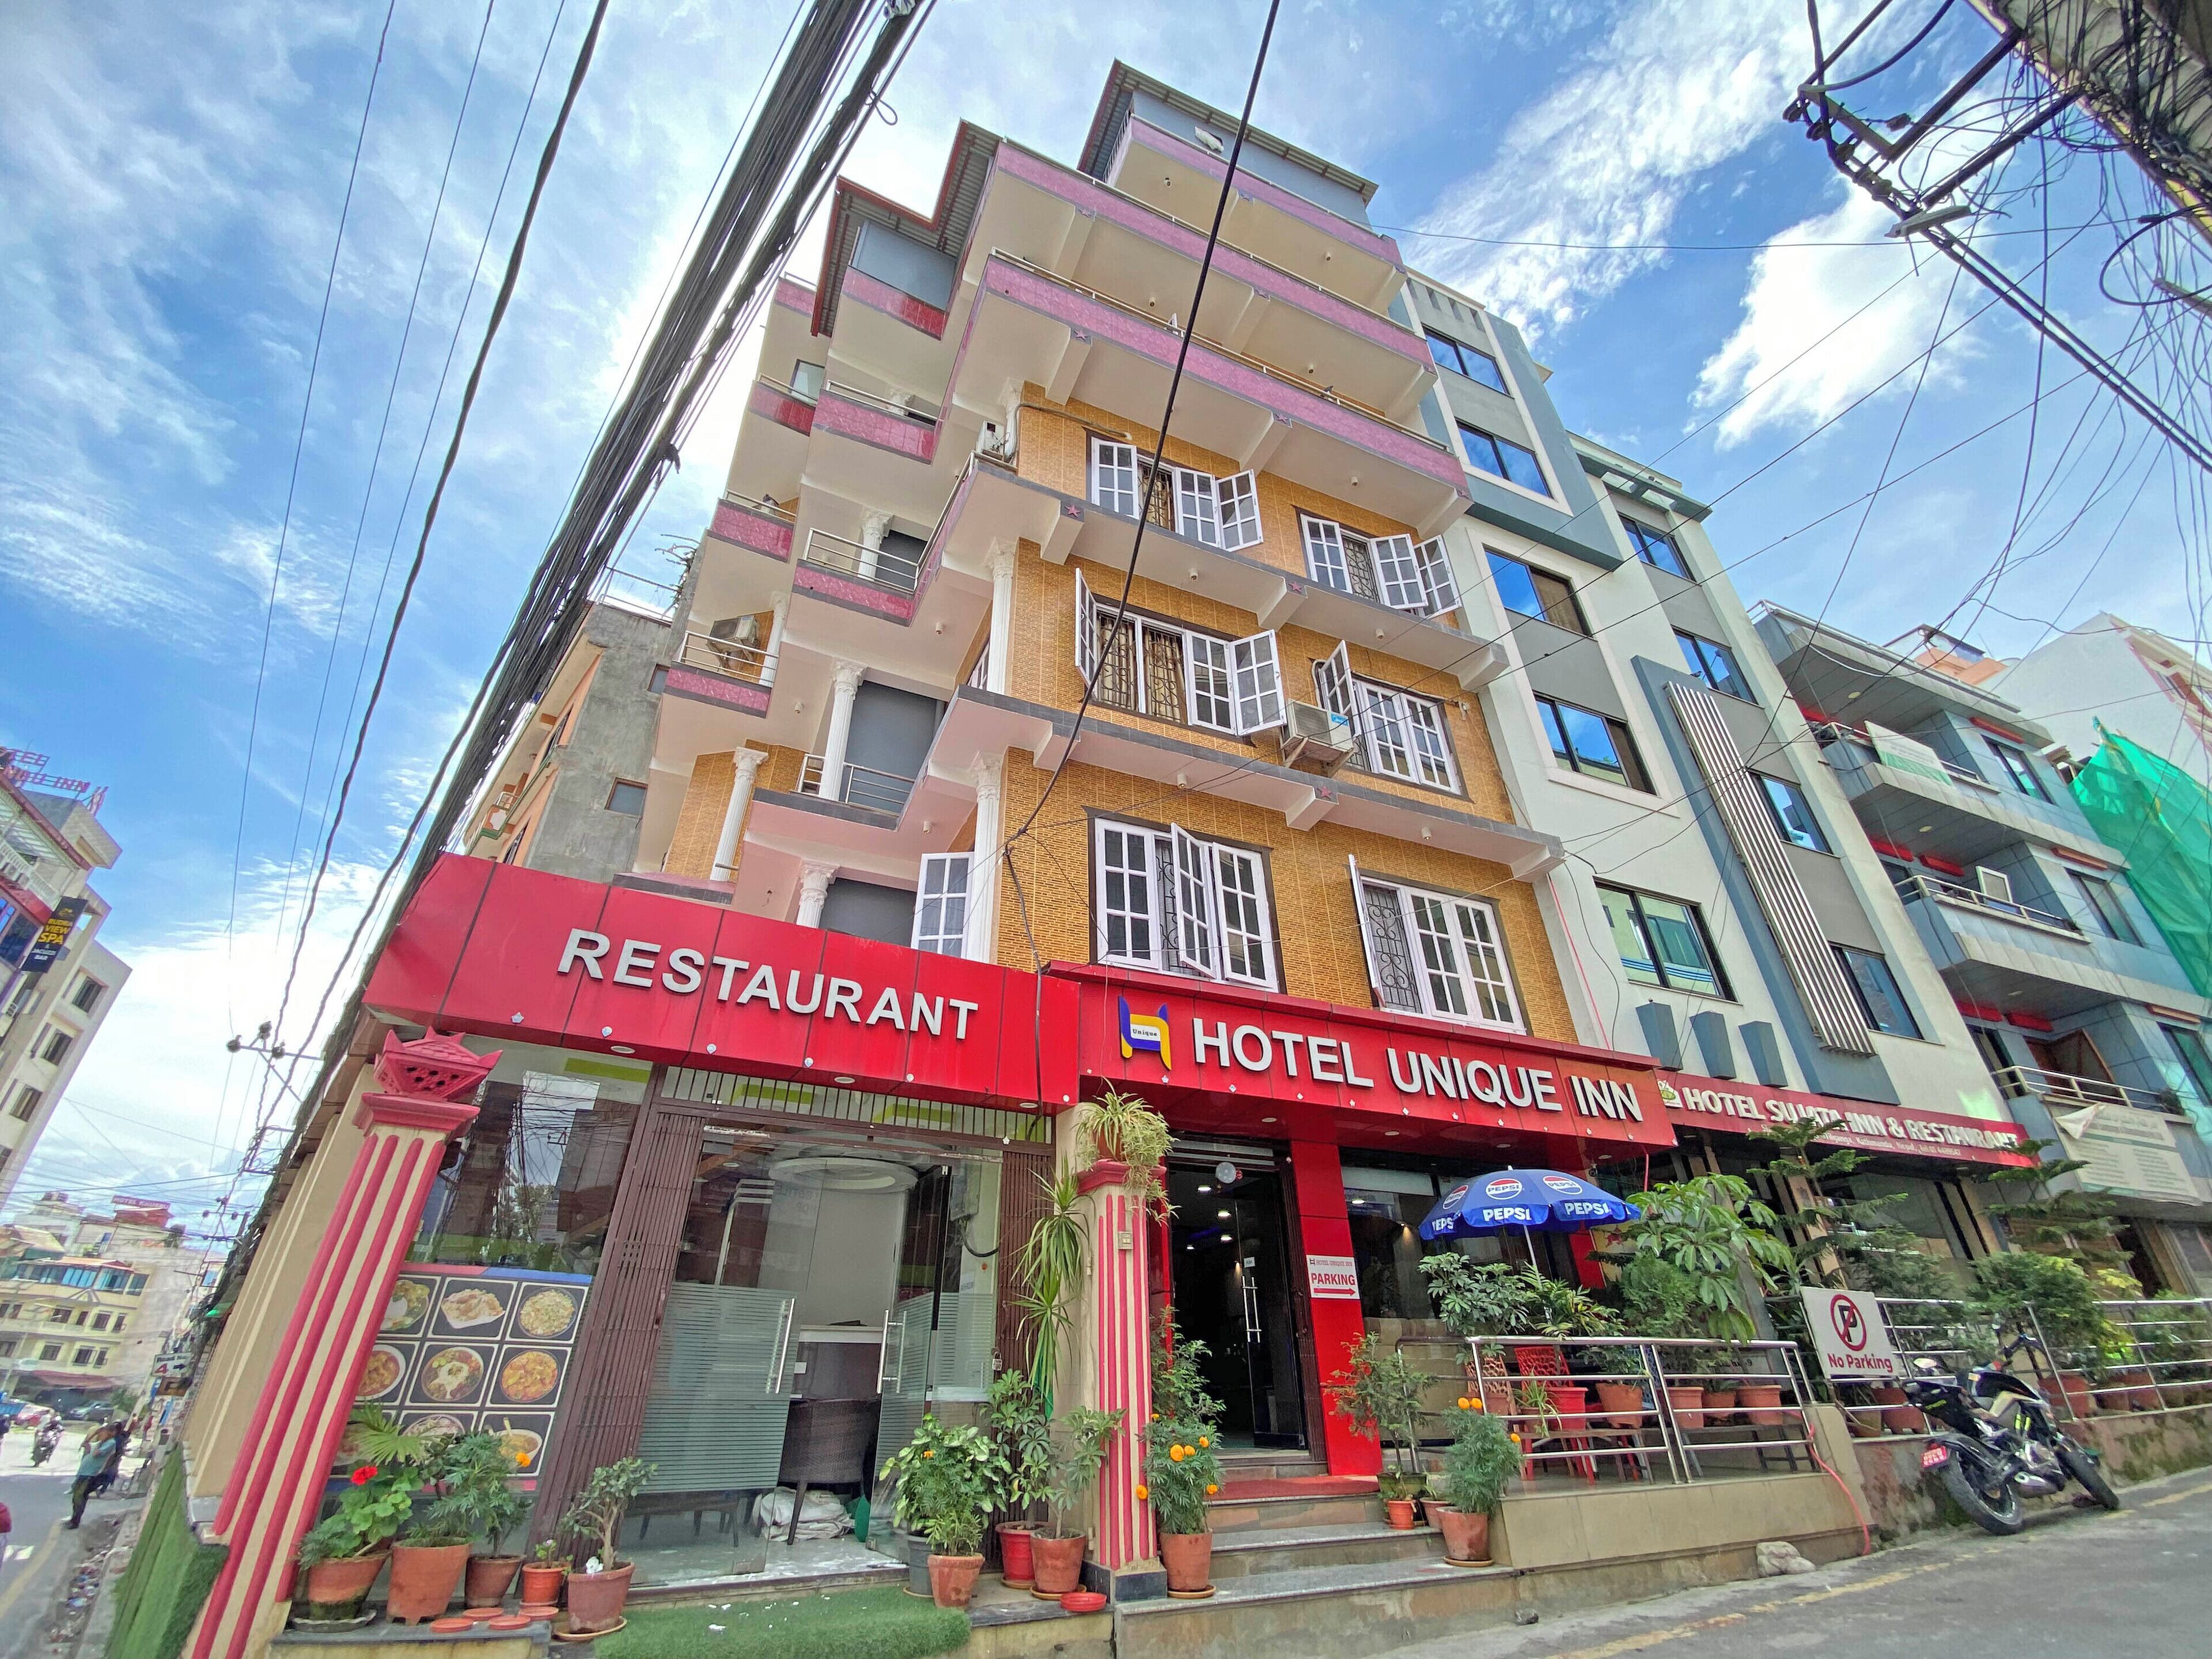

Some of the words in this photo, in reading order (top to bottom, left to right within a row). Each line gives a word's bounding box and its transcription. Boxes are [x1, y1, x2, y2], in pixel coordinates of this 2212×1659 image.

[44, 925, 70, 934] VIEW
[38, 932, 63, 945] SPA
[557, 928, 978, 1039] RESTAURANT
[1193, 1017, 1374, 1088] HOTEL
[1387, 1048, 1563, 1112] UNIQUE
[1571, 1075, 1643, 1122] INN
[1681, 1086, 1767, 1120] HOTEL
[1844, 1112, 1888, 1136] INN
[1885, 1117, 1908, 1139] &
[1903, 1119, 2018, 1149] RESTAURANT
[1487, 1184, 1520, 1192] PEPSI
[1483, 1207, 1532, 1222] PEPSI
[1565, 1202, 1612, 1215] PEPSI
[1311, 1272, 1355, 1285] PARKING
[154, 1363, 169, 1374] 4
[1827, 1353, 1844, 1368] No
[1846, 1354, 1893, 1373] Parking
